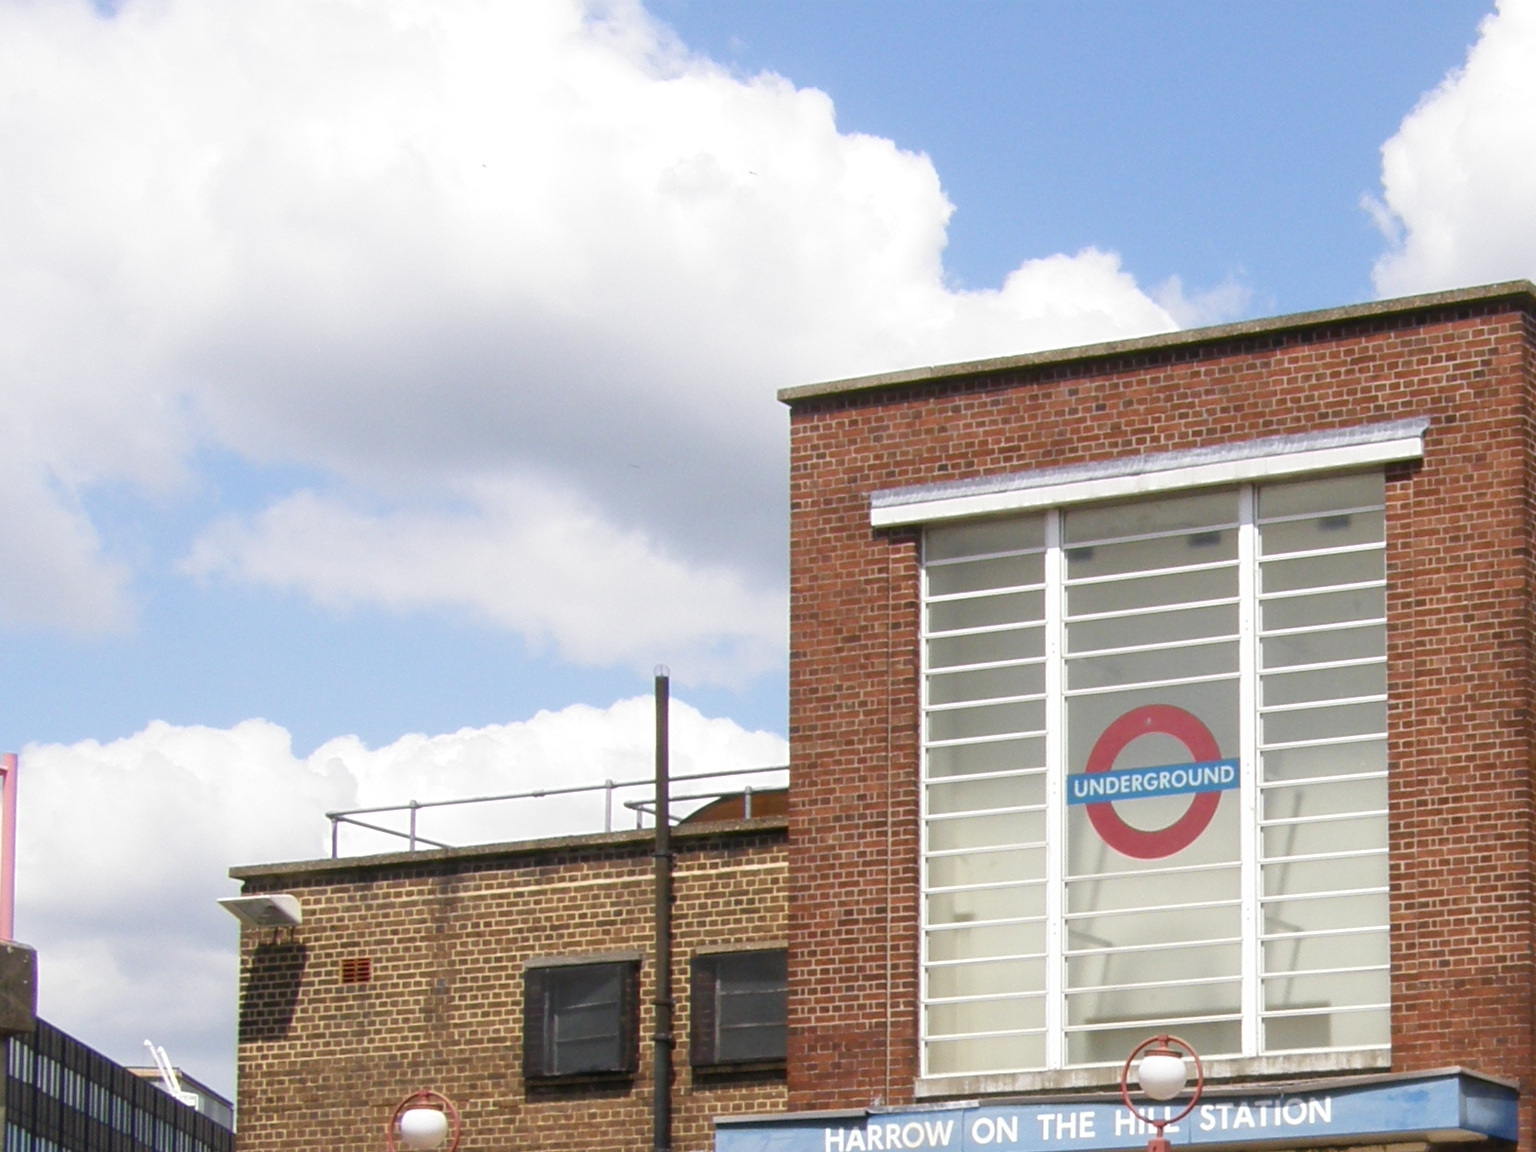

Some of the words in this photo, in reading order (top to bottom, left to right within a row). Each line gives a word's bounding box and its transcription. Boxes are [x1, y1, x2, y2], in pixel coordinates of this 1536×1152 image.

[1074, 765, 1235, 797] UNDERGROUND
[825, 1120, 954, 1152] HARROW
[972, 1117, 1018, 1144] ON
[1038, 1111, 1095, 1140] THE
[1115, 1105, 1179, 1137] HILL
[1200, 1098, 1333, 1131] STATION
